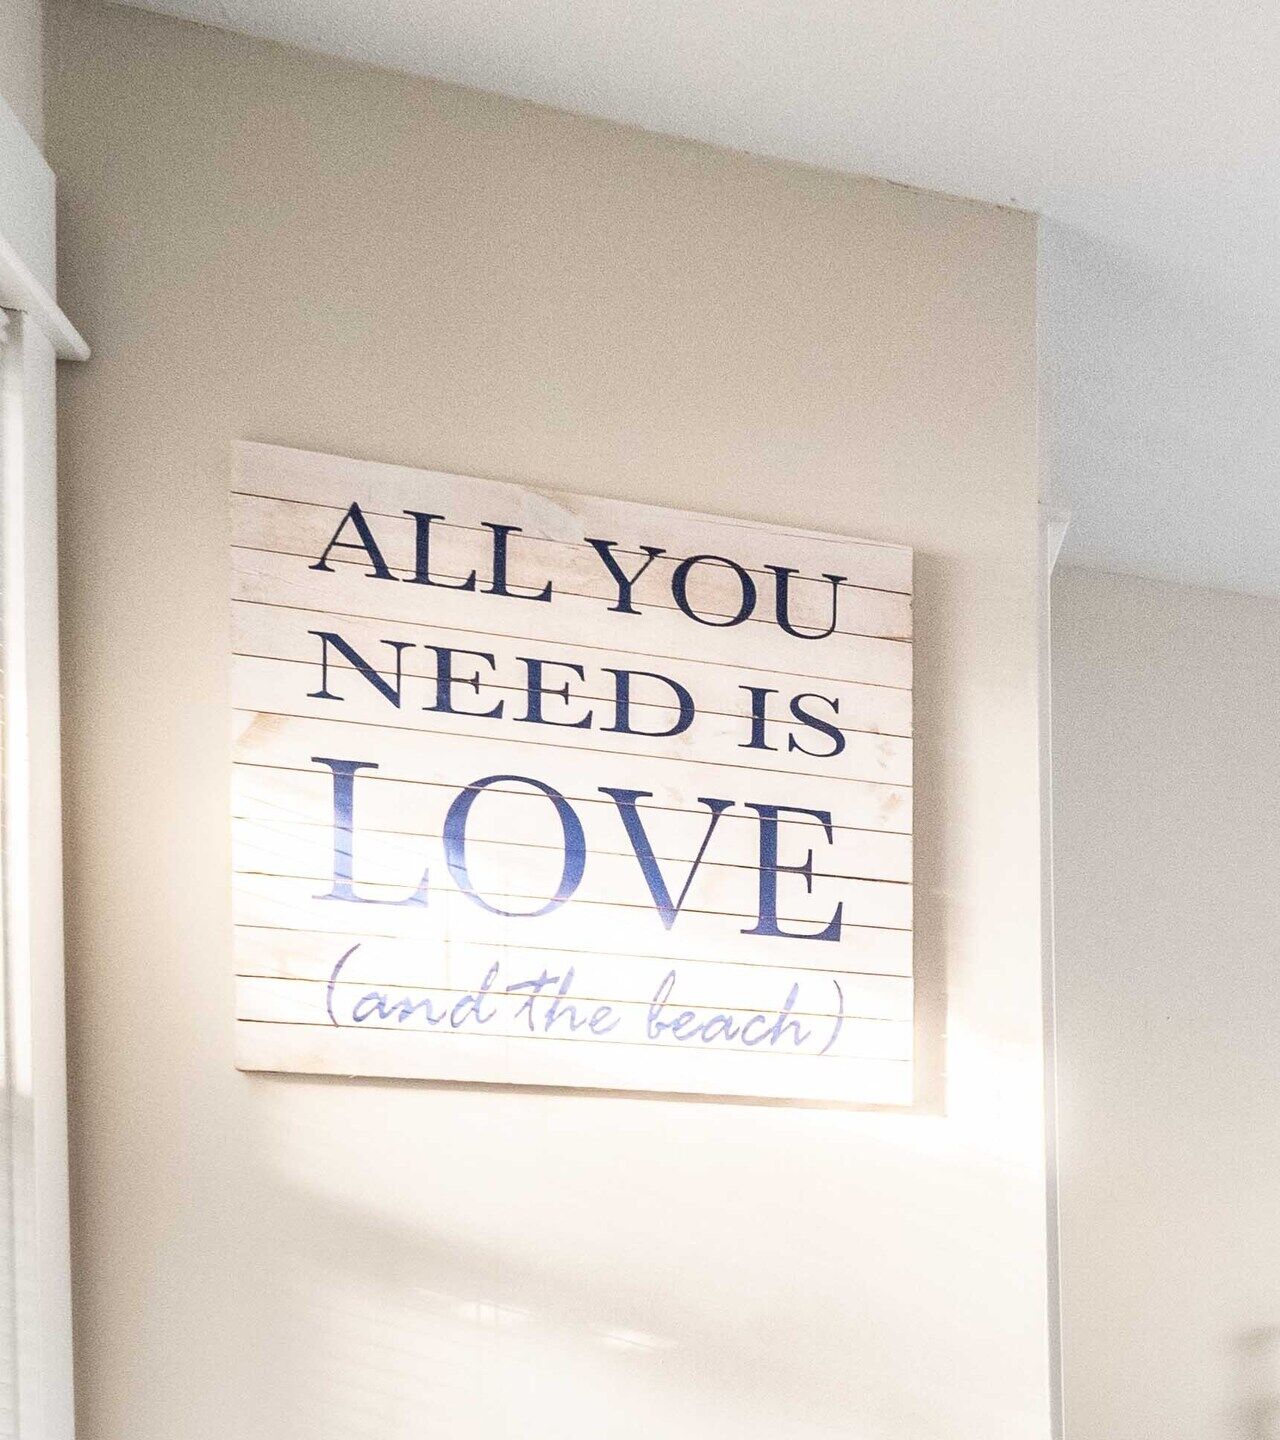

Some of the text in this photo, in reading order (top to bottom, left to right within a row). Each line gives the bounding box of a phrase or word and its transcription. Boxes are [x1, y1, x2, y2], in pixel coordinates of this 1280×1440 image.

[308, 501, 848, 640] ALL YOU
[305, 630, 847, 758] NEED IS
[310, 756, 844, 942] LOVE
[325, 943, 845, 1056] (and the beach)
